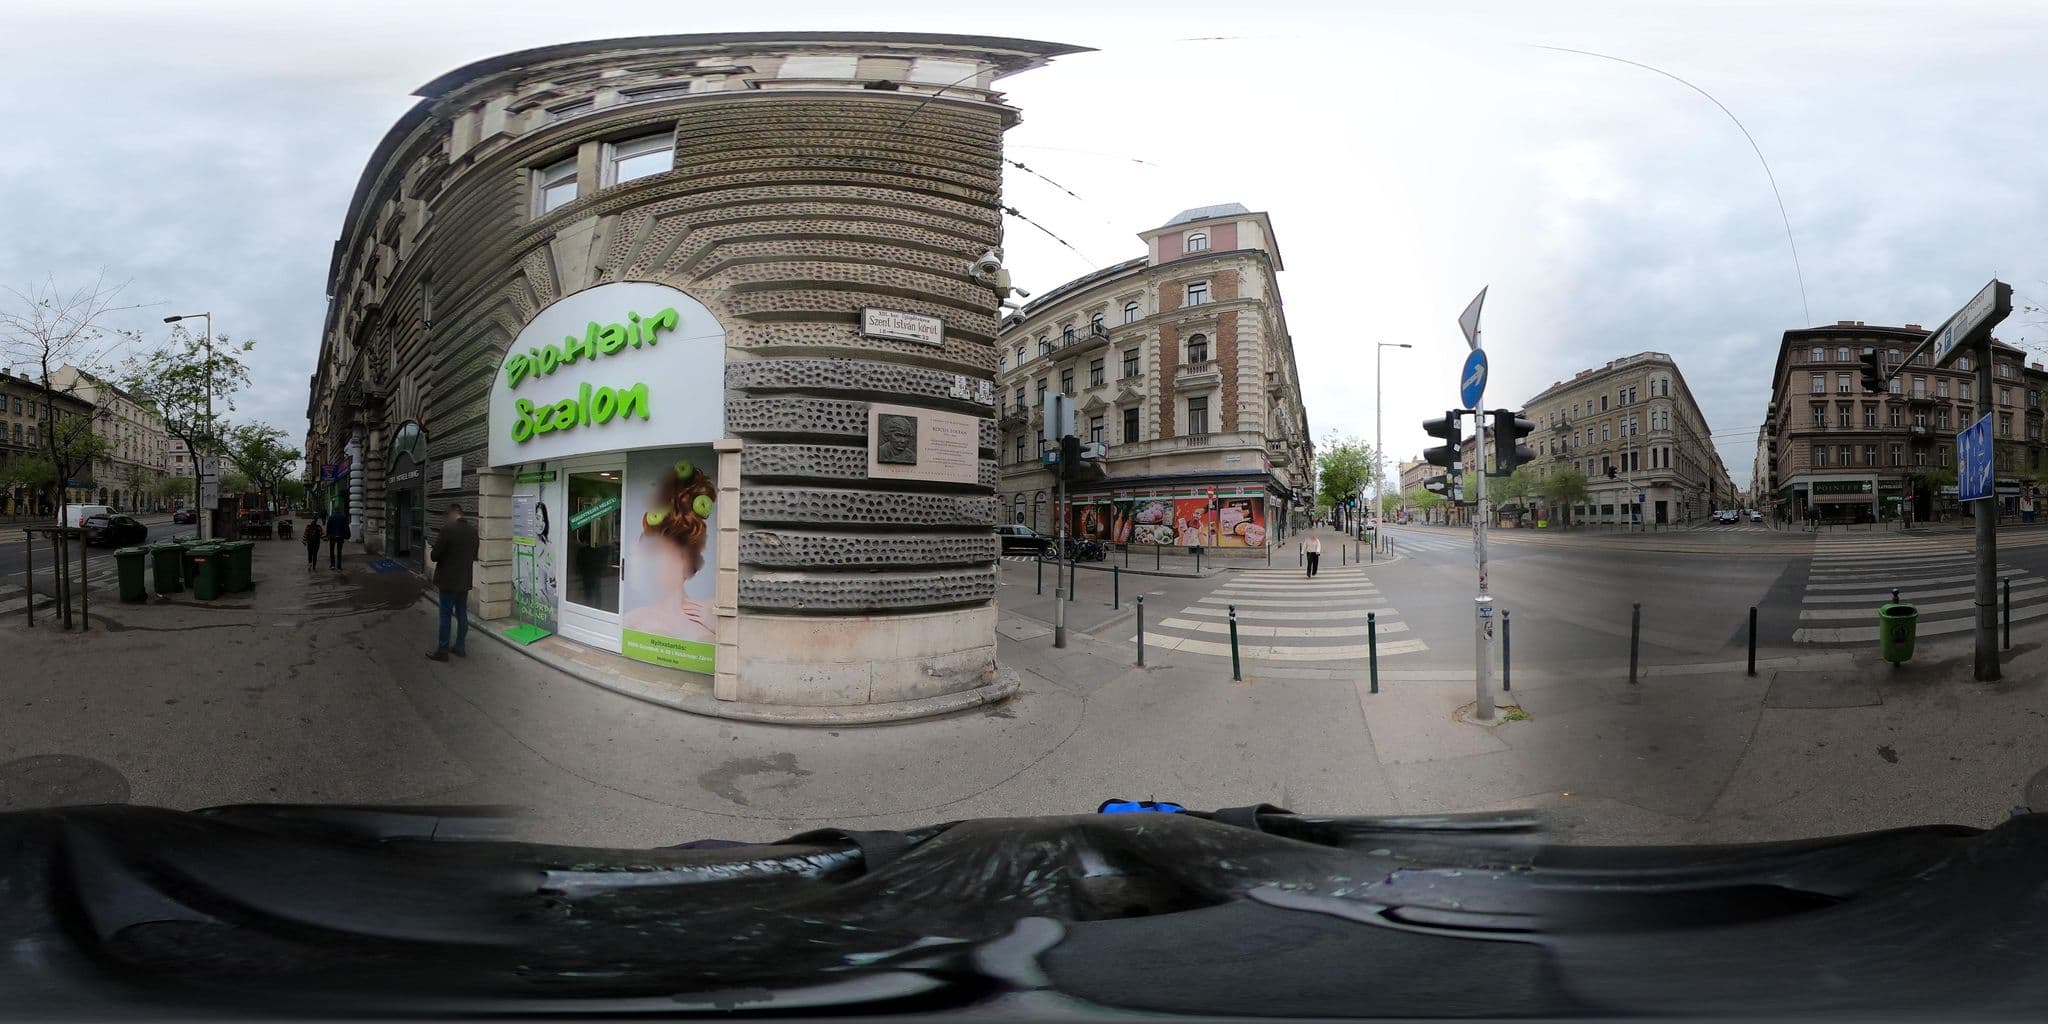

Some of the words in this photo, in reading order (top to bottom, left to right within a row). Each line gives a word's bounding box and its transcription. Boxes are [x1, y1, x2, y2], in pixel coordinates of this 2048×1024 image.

[869, 315, 890, 328] Szent
[893, 318, 916, 332] István
[918, 321, 938, 335] körút
[510, 381, 650, 444] Szalon
